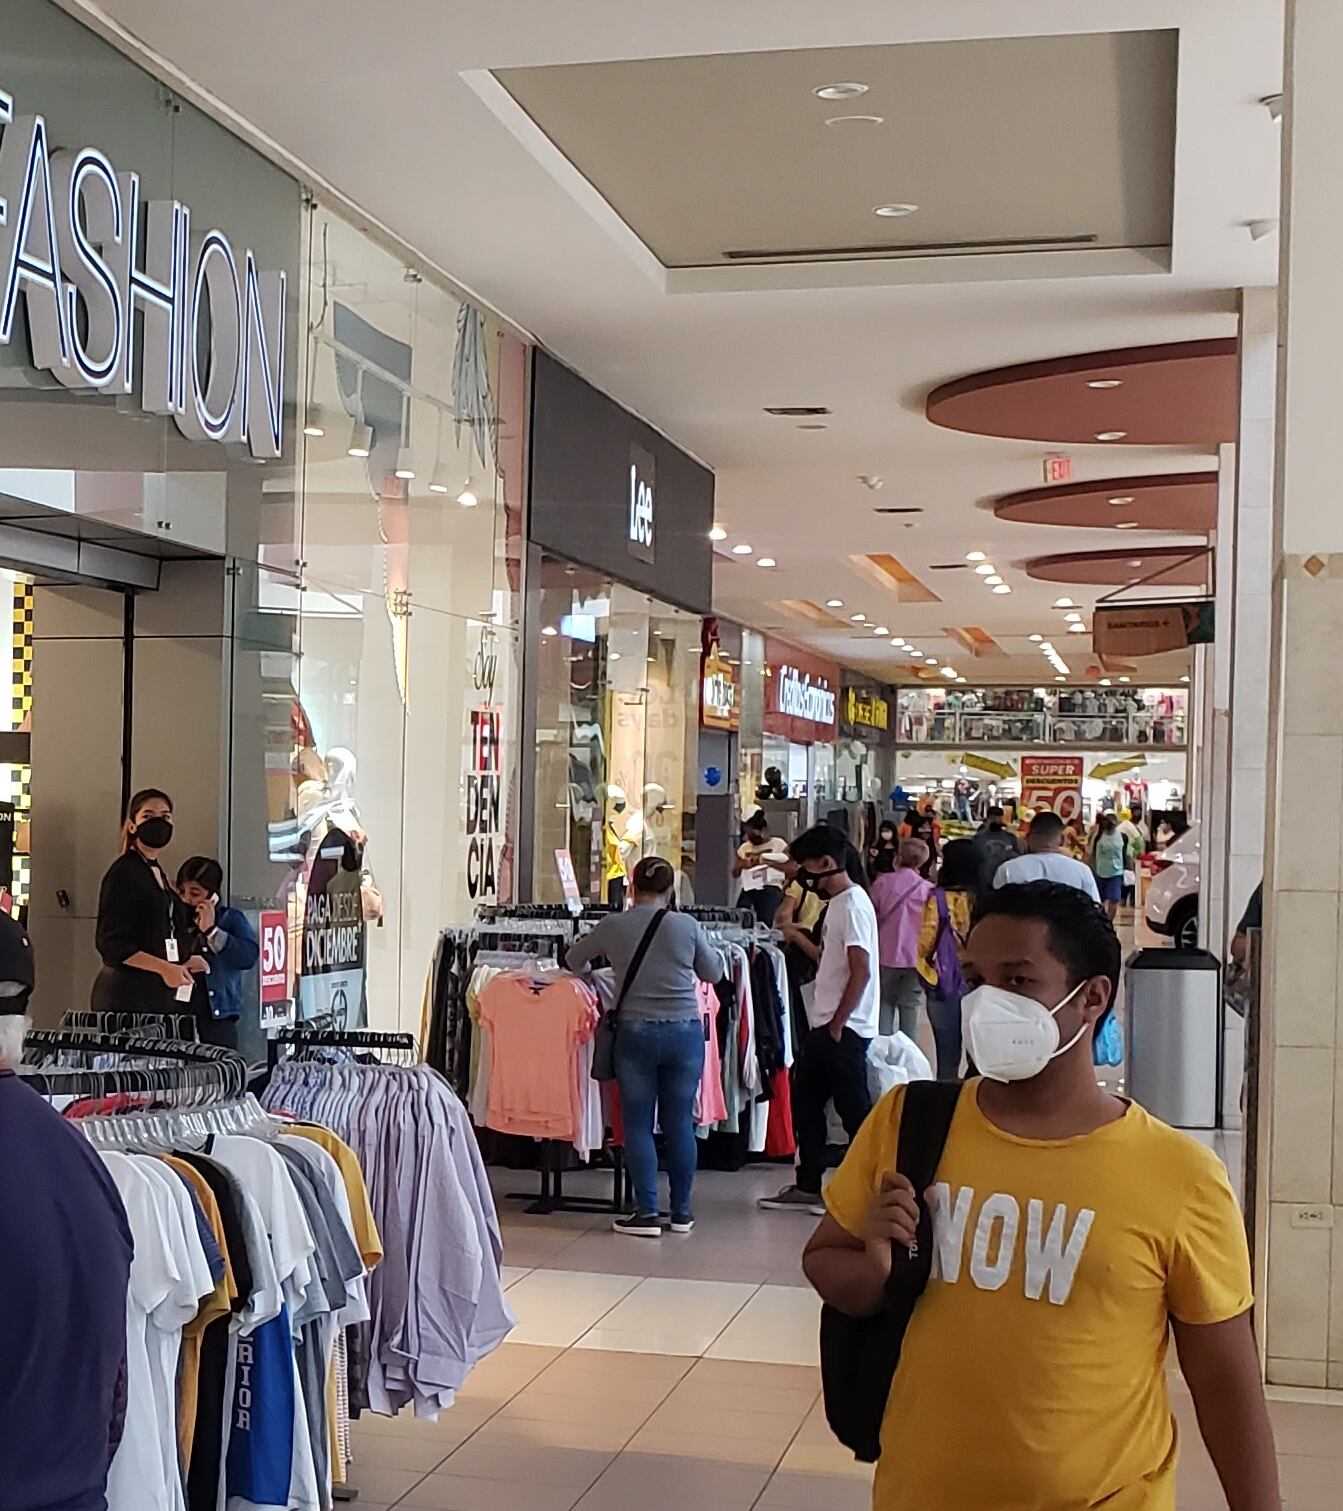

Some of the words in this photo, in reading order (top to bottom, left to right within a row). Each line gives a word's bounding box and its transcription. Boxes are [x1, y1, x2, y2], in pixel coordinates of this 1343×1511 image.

[630, 464, 652, 547] Lee
[470, 711, 501, 772] TEN
[1031, 765, 1076, 775] SUPER
[466, 775, 499, 835] DEN
[1027, 789, 1082, 825] 50
[467, 837, 496, 899] CIA
[307, 894, 332, 924] PAGA
[263, 925, 286, 973] 50
[306, 926, 358, 968] DICIEMBRE
[236, 1336, 255, 1431] RIOR
